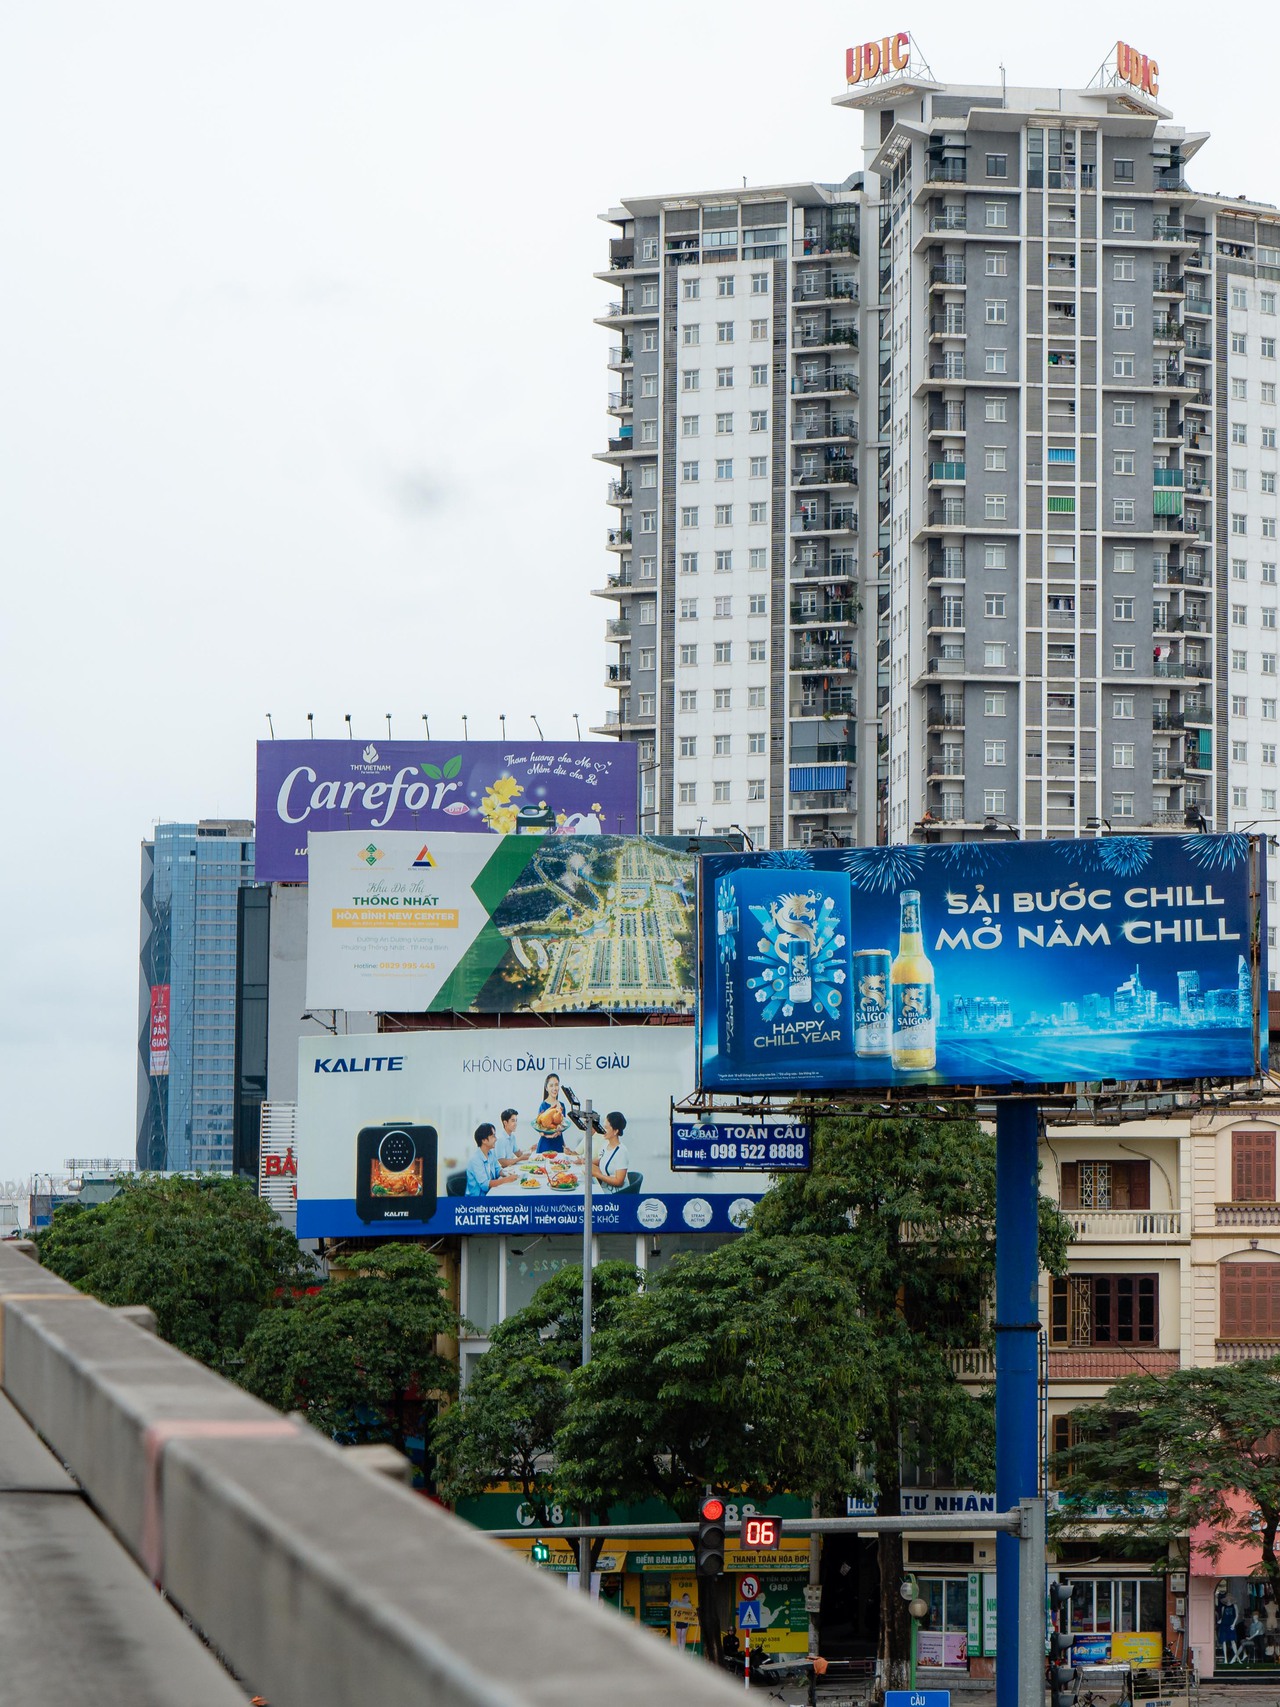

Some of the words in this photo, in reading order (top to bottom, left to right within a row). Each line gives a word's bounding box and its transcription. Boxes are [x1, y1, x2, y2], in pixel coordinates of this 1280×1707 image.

[846, 31, 909, 84] UDIC
[1117, 41, 1159, 97] UDIC
[558, 753, 572, 763] cho
[569, 769, 583, 780] cho
[277, 766, 458, 827] Carefor
[366, 879, 387, 893] Khu
[353, 894, 399, 906] THỐNG
[403, 894, 439, 906] NHẤT
[947, 884, 1000, 914] SẢI
[1013, 881, 1112, 913] BƯỚC
[1124, 885, 1225, 908] CHILL
[336, 910, 359, 920] HÒA
[361, 910, 386, 920] BÌNH
[388, 912, 412, 920] NEW
[414, 912, 455, 920] CENTER
[935, 917, 1003, 950] MỞ
[1018, 918, 1111, 948] NĂM
[1124, 917, 1240, 945] CHILL
[772, 1020, 825, 1034] HAPPY
[151, 1038, 168, 1047] GIAO
[753, 1034, 799, 1048] CHILL
[801, 1030, 840, 1043] YEAR
[314, 1056, 404, 1073] KALITE
[462, 1056, 513, 1072] KHÔNG
[516, 1052, 546, 1071] DẦU
[549, 1053, 572, 1070] THÌ
[575, 1053, 594, 1070] SẼ
[596, 1053, 631, 1069] GIÀU
[677, 1126, 719, 1140] GLOBAL
[724, 1124, 768, 1139] TOÀN
[774, 1124, 806, 1139] CẦU
[676, 1149, 693, 1158] LIÊN
[694, 1149, 707, 1160] HỆ:
[710, 1144, 737, 1159] 098
[740, 1144, 766, 1159] 522
[769, 1143, 804, 1159] 8888
[455, 1204, 467, 1213] NỒI
[468, 1204, 489, 1213] CHIÊN
[489, 1204, 514, 1213] KHÔNG
[514, 1203, 529, 1213] DẦU
[534, 1203, 549, 1213] NẤU
[550, 1204, 577, 1213] NƯỚNG
[604, 1203, 620, 1212] DẦU
[455, 1215, 492, 1226] KALITE
[493, 1214, 529, 1225] STEAM
[534, 1214, 557, 1225] THÊM
[557, 1213, 578, 1224] GIÀU
[902, 1494, 929, 1510] TƯ
[935, 1495, 994, 1511] NHÂN
[746, 1521, 774, 1545] 06
[656, 1554, 671, 1564] BÁN
[732, 1555, 756, 1563] THANH
[758, 1554, 776, 1563] TOÁN
[778, 1554, 793, 1563] HÓA
[910, 1693, 925, 1706] CẦU
